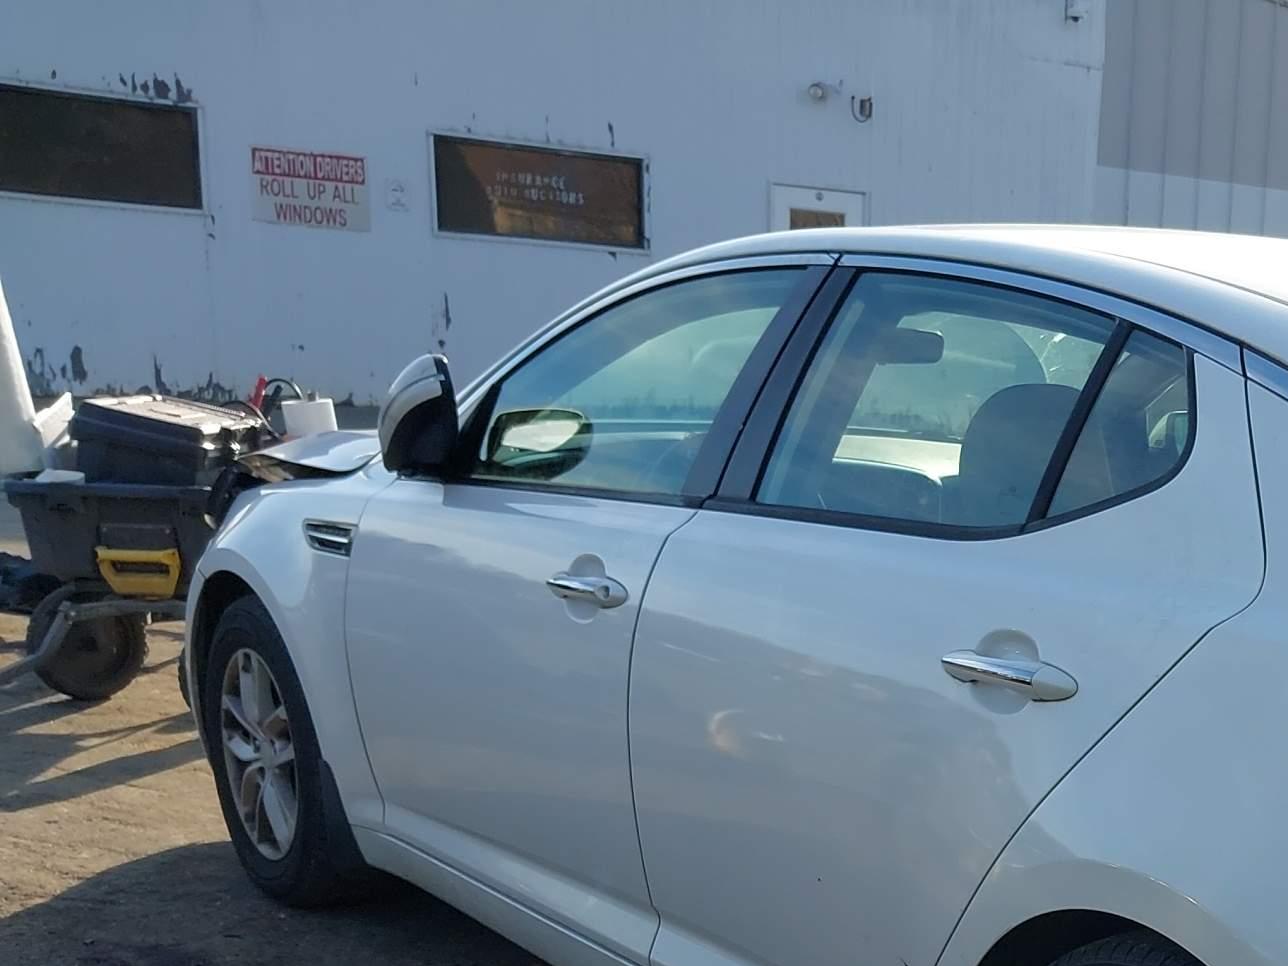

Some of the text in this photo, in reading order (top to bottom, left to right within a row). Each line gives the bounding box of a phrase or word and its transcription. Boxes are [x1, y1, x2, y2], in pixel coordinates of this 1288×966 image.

[254, 151, 364, 181] ATTENTION DRIVERS
[260, 179, 359, 205] ROLL UP ALL
[274, 202, 347, 227] WINDOWS
